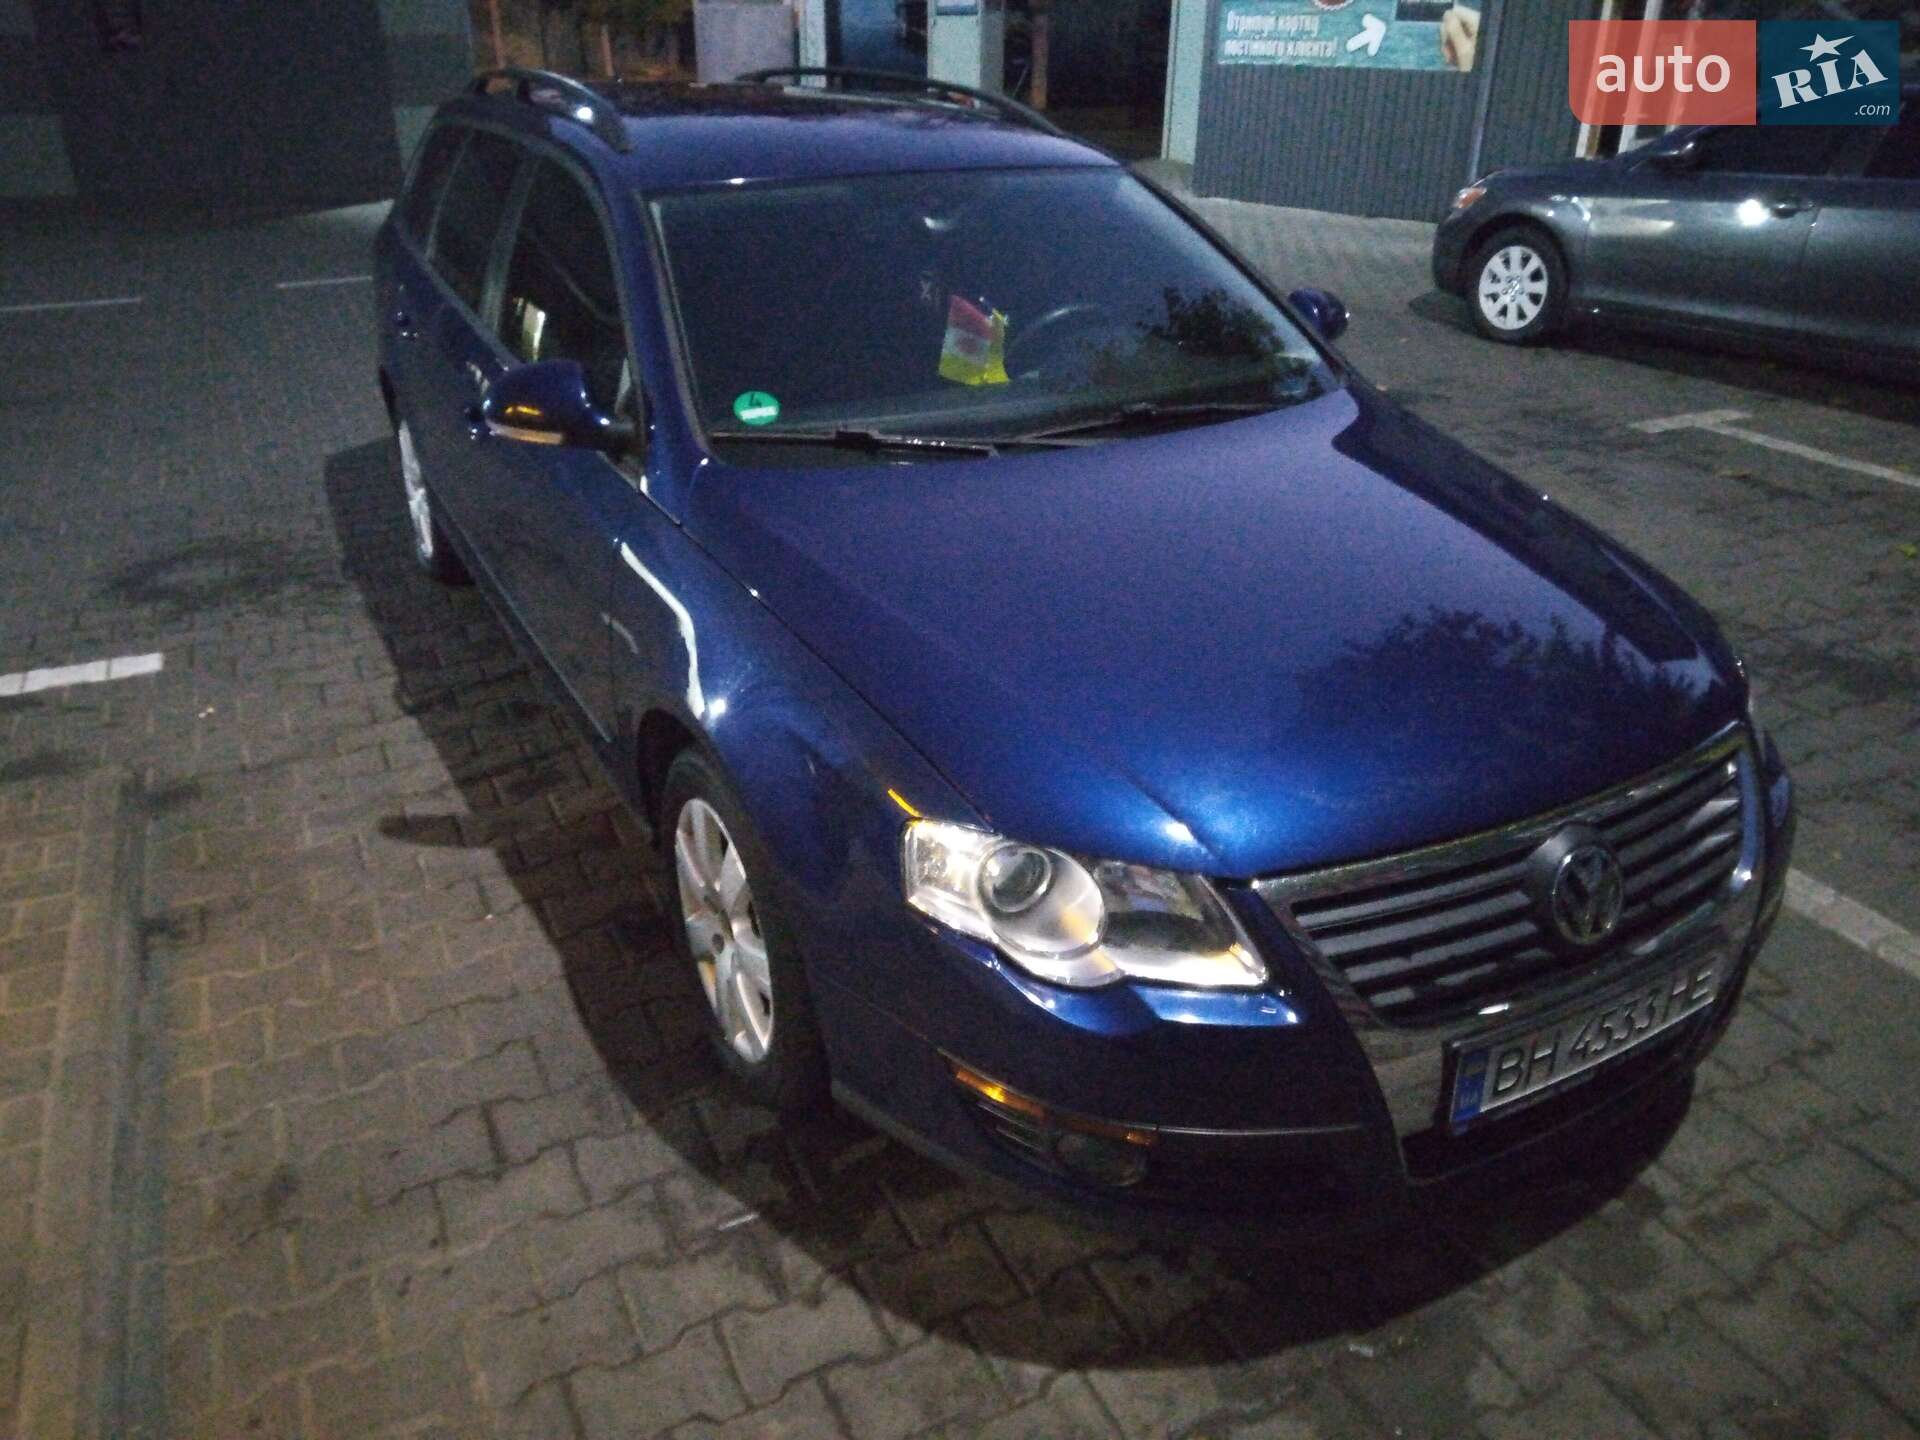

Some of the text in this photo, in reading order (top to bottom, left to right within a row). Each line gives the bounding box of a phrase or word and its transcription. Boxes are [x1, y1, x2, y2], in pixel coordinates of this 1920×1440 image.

[1493, 957, 1717, 1093] BH 4533 HE
